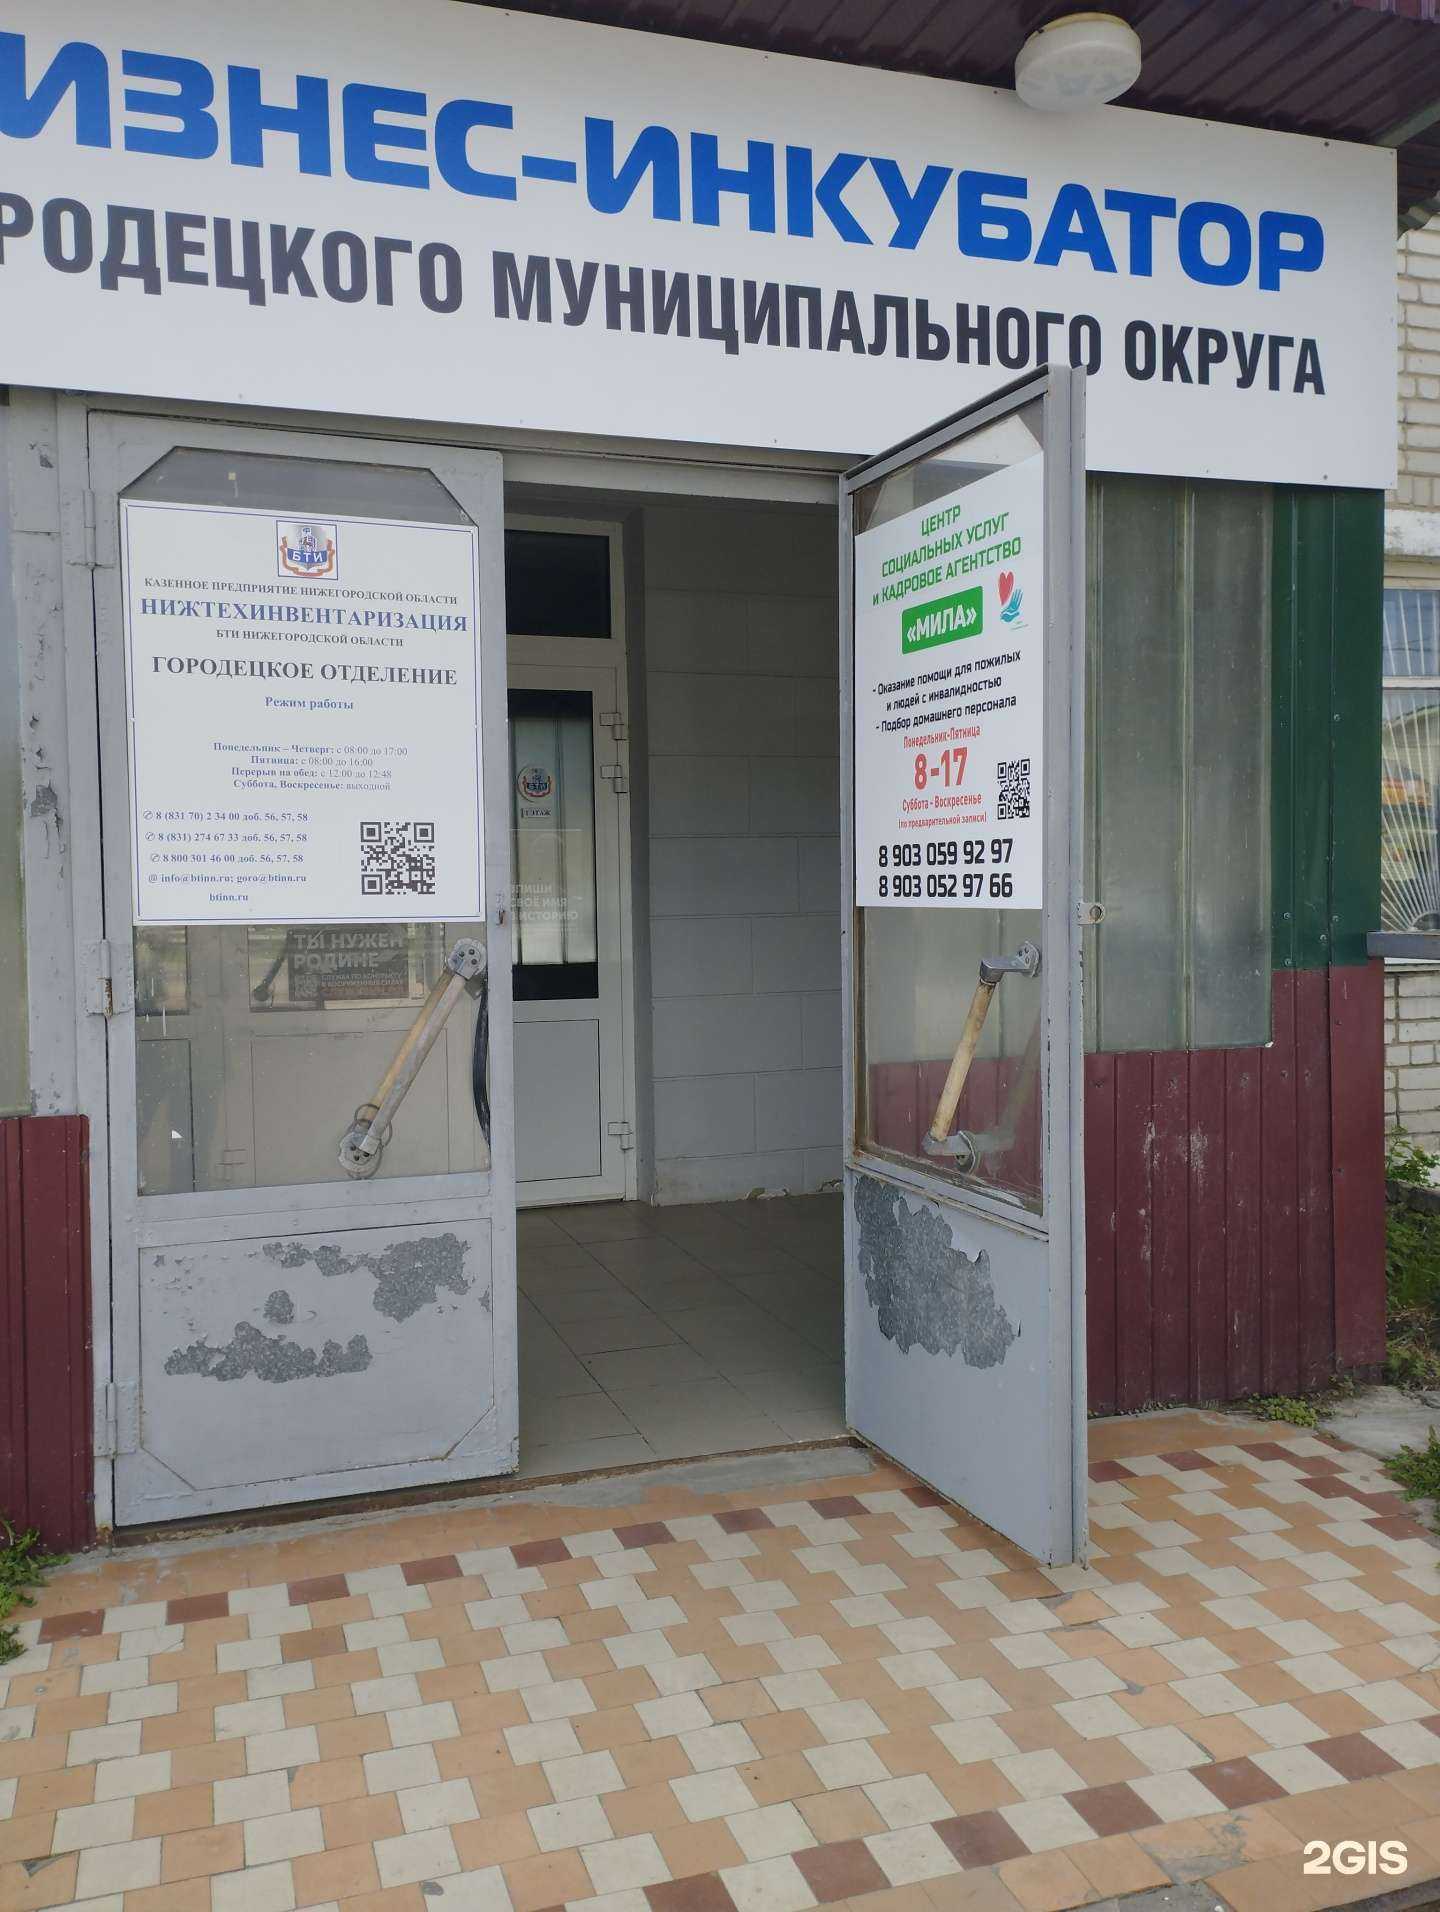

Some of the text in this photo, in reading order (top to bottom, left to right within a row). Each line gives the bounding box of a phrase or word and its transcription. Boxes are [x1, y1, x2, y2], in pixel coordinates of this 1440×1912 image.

[491, 250, 1101, 376] МУНИЦИПАЛЬНОГО
[1124, 319, 1326, 396] ОКРУГА
[921, 505, 961, 536] ЦЕНТР
[291, 550, 325, 563] БТИ
[882, 512, 1009, 577] СОЦИАЛЬНЫХ УСЛУГ
[882, 566, 943, 603] КАДРОВОЕ
[946, 537, 1021, 580] АГЕНТСТВО
[144, 577, 458, 605] КАЗЕННОЕ ПРЕДПРИЯТИЕ НИЖЕГОРОДСКОЙ ОБЛАСТИ
[141, 598, 468, 633] НИЖТЕХИНВЕНТАРИЗАЦИЯ
[906, 605, 977, 643] «МИЛА»
[216, 630, 404, 647] БТИ НИЖЕГОРОДСКОЙ ОБЛАСТИ
[152, 656, 458, 686] ГОРОДЕЦКОЕ ОТДЕЛЕНИЕ
[877, 678, 915, 695] Оказание
[917, 667, 952, 685] помощи
[954, 662, 972, 678] для
[974, 650, 1021, 671] пожилых
[265, 697, 354, 712] Режим работы
[886, 677, 1002, 711] и людей с инвалидностью
[881, 717, 911, 733] Подбор
[913, 709, 962, 727] домашнего
[965, 695, 1017, 716] персонала
[915, 747, 968, 790] 8-17
[155, 812, 162, 820] 8
[165, 811, 184, 821] (831
[188, 812, 203, 821] 70)
[264, 814, 278, 822] 56,
[297, 814, 308, 822] 58
[902, 799, 929, 814] Суббота
[935, 793, 982, 809] Воскресенье
[158, 833, 164, 841] 8
[167, 833, 191, 842] (831)
[195, 833, 211, 842] 274
[213, 834, 225, 842] 67
[229, 833, 239, 841] 33
[264, 834, 278, 842] 56,
[296, 834, 307, 842] 58
[163, 854, 169, 862] 8
[171, 854, 188, 862] 800
[191, 854, 206, 862] 301
[210, 854, 222, 863] 46
[260, 855, 274, 863] 56,
[292, 855, 304, 863] 58
[878, 838, 1013, 867] 8 903 059 92 97
[210, 893, 249, 902] btinn.ru
[878, 873, 1013, 897] 8 903 052 97 66
[294, 932, 404, 949] ТЫ НУЖЕН
[294, 952, 380, 973] РОДИНЕ
